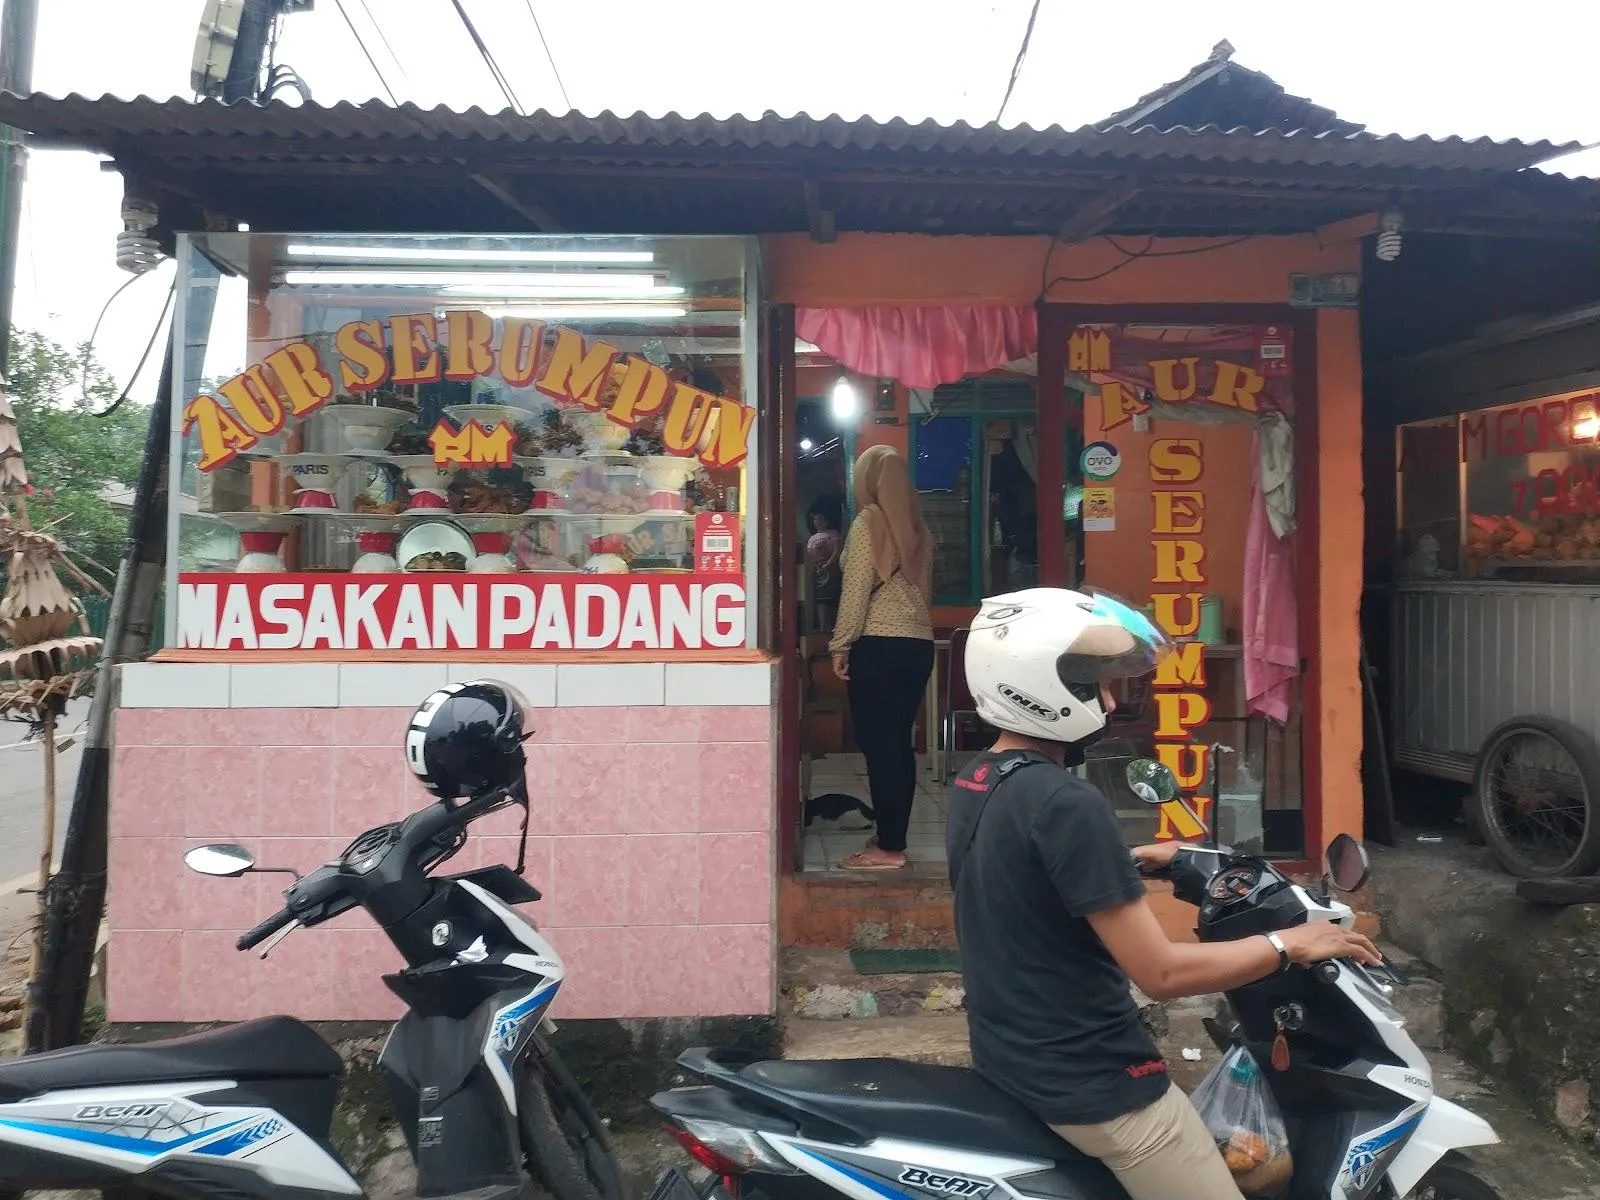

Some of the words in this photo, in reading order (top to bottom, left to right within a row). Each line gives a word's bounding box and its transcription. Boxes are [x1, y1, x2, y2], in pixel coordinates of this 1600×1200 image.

[183, 342, 333, 473] AUR
[337, 310, 756, 471] SERUMPUN
[1100, 357, 1266, 432] AUR
[292, 464, 329, 475] PARIS
[428, 417, 518, 468] RM
[177, 582, 479, 649] MASAKAN
[489, 582, 746, 649] PADANG
[1149, 438, 1212, 843] SERUMPUN
[1003, 688, 1054, 717] INK
